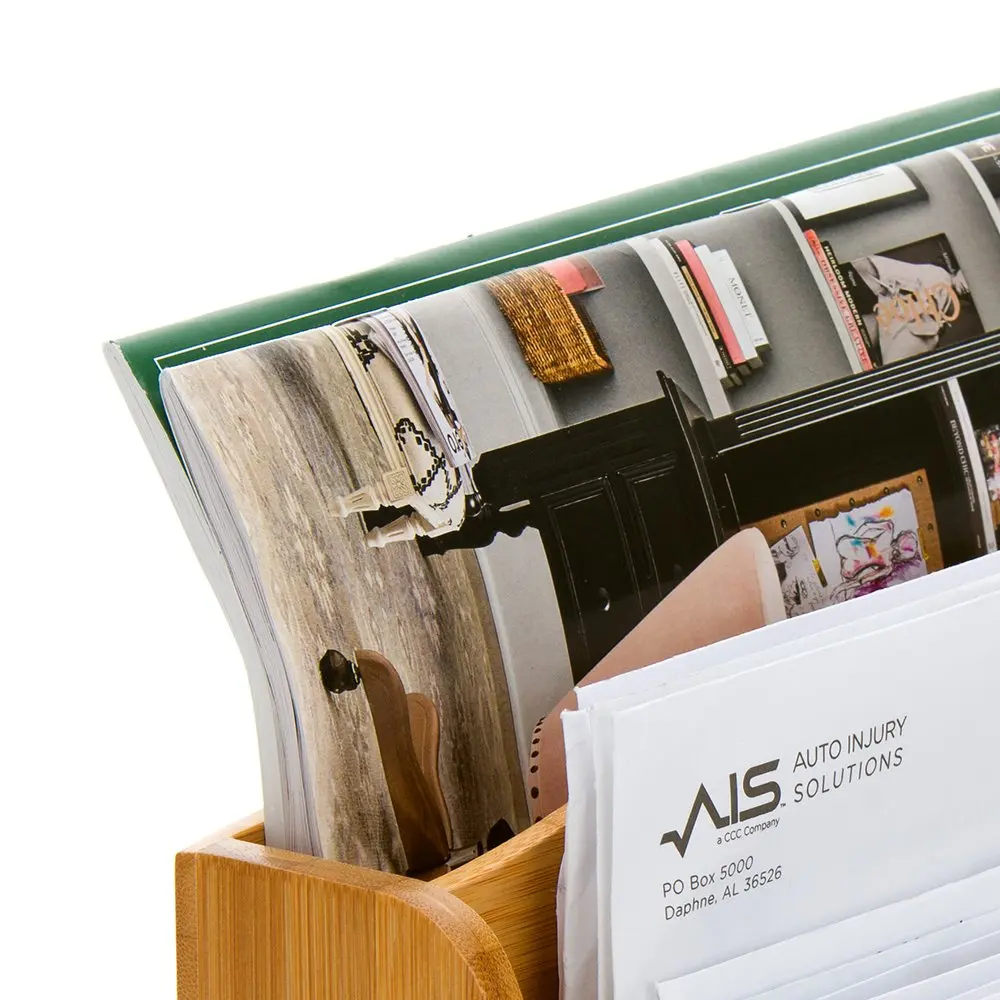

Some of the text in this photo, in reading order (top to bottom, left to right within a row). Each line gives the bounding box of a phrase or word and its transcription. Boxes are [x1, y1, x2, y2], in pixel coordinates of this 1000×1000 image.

[728, 276, 754, 318] MONET
[823, 245, 848, 288] HEIRLOOM
[843, 288, 863, 327] MODERN
[949, 419, 964, 456] BEYOND
[792, 715, 907, 774] AUTO INJURY
[793, 747, 904, 804] SOLUTIONS
[716, 816, 781, 845] a CCC Company
[662, 855, 754, 898] PO Box 5000
[664, 865, 783, 921] Daphne, AL 36526
